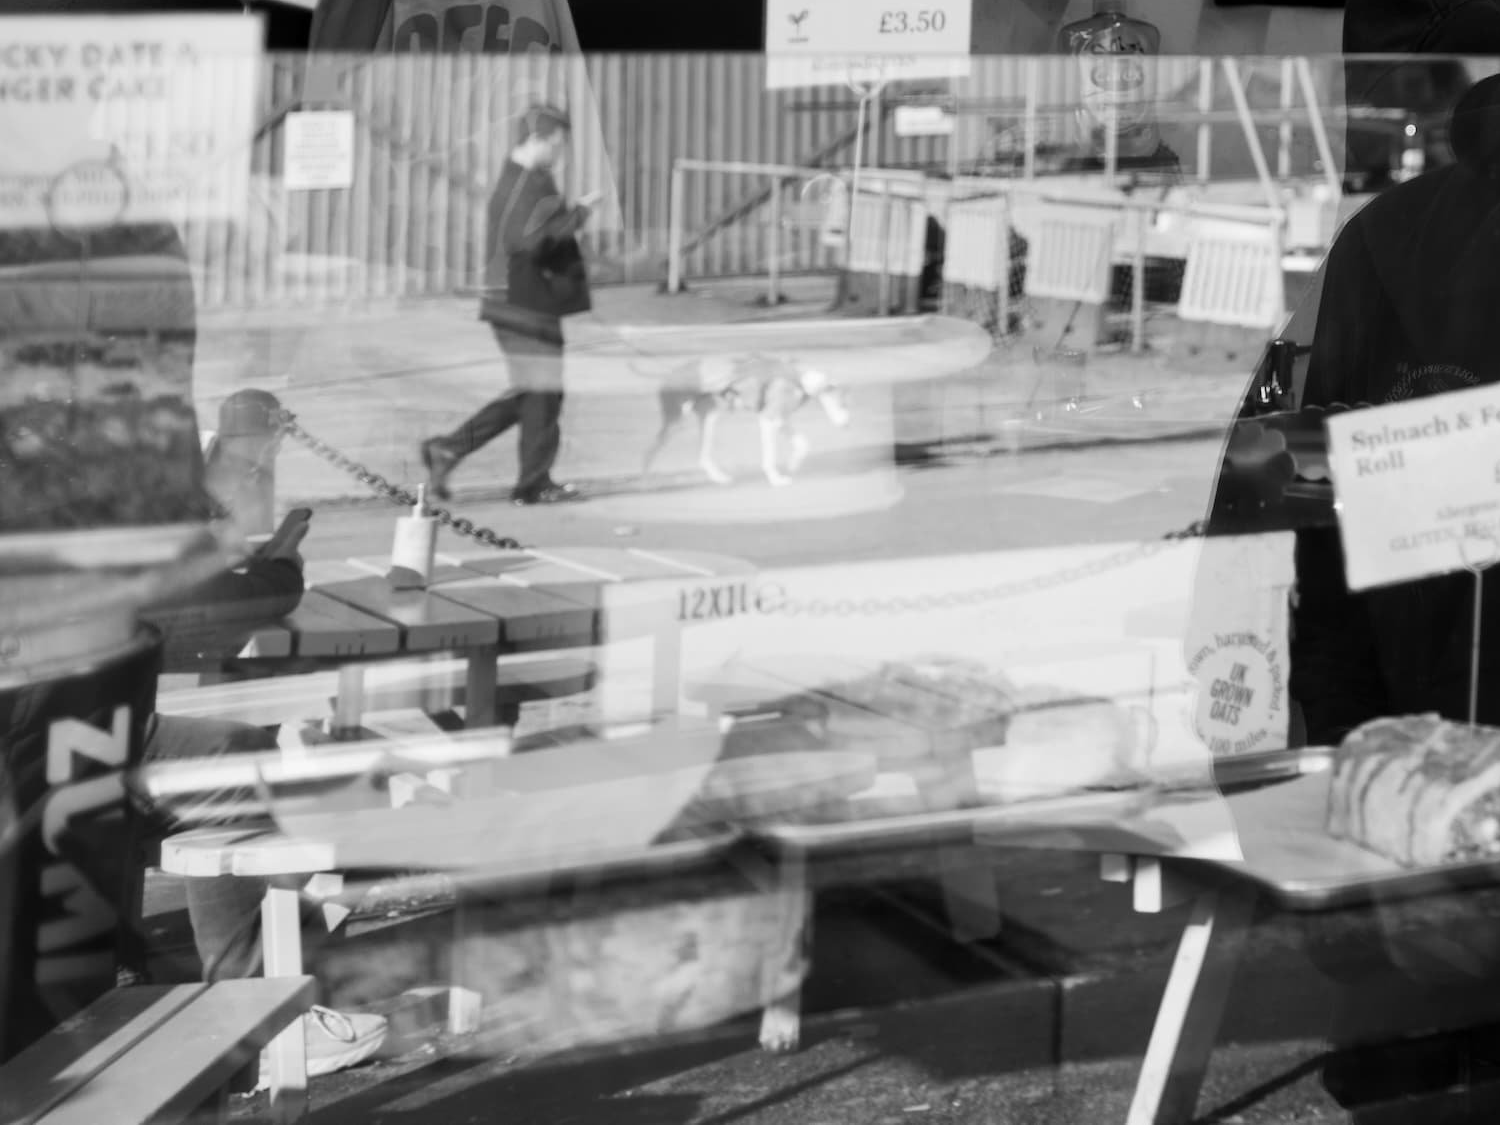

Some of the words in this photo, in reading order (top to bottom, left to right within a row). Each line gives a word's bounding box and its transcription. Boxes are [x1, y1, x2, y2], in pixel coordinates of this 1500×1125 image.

[878, 9, 947, 35] £3.50
[1351, 414, 1451, 452] Spinach
[1455, 410, 1472, 431] &
[1357, 450, 1406, 478] Roll
[1209, 676, 1256, 708] GROWN
[1208, 699, 1243, 727] OATS
